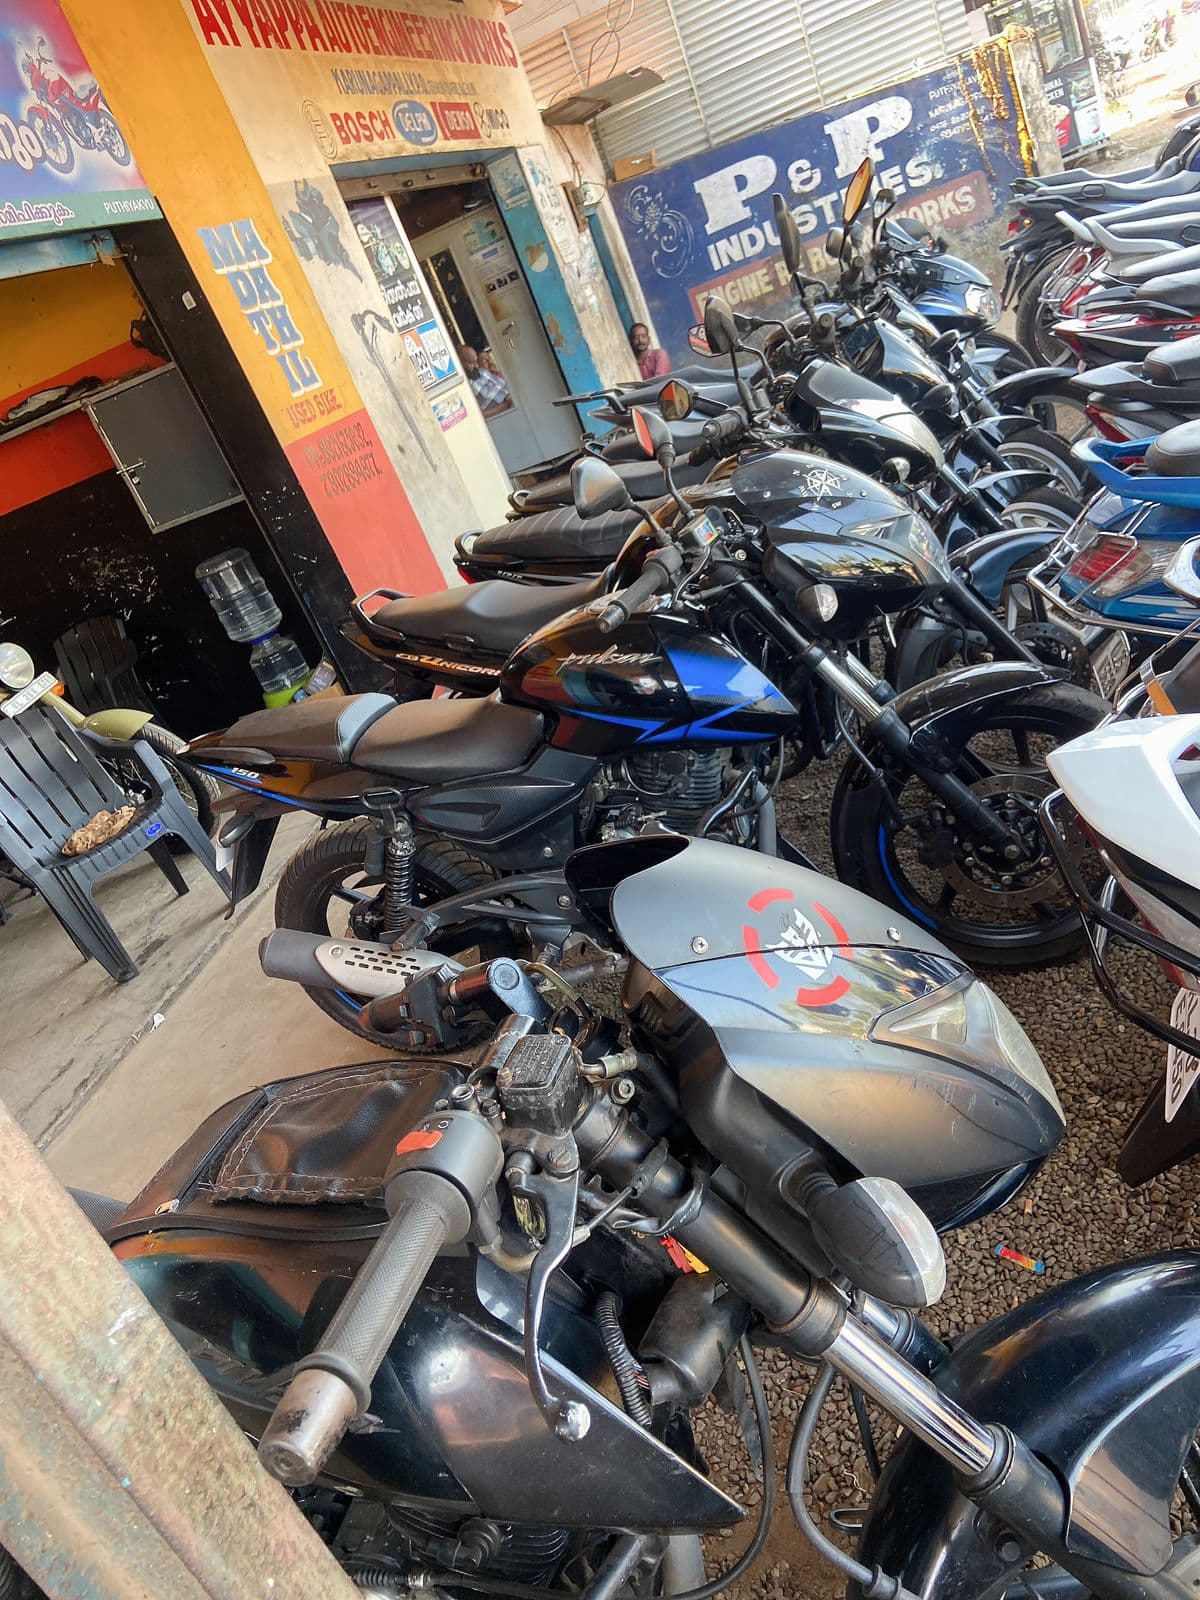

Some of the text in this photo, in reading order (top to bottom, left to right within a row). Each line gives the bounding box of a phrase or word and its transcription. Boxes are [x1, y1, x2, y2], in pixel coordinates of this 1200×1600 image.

[449, 13, 518, 68] WORKS
[330, 110, 396, 145] BOSCH
[693, 96, 913, 235] P & P
[705, 155, 933, 271] INDUSTIES
[231, 767, 260, 779] 150
